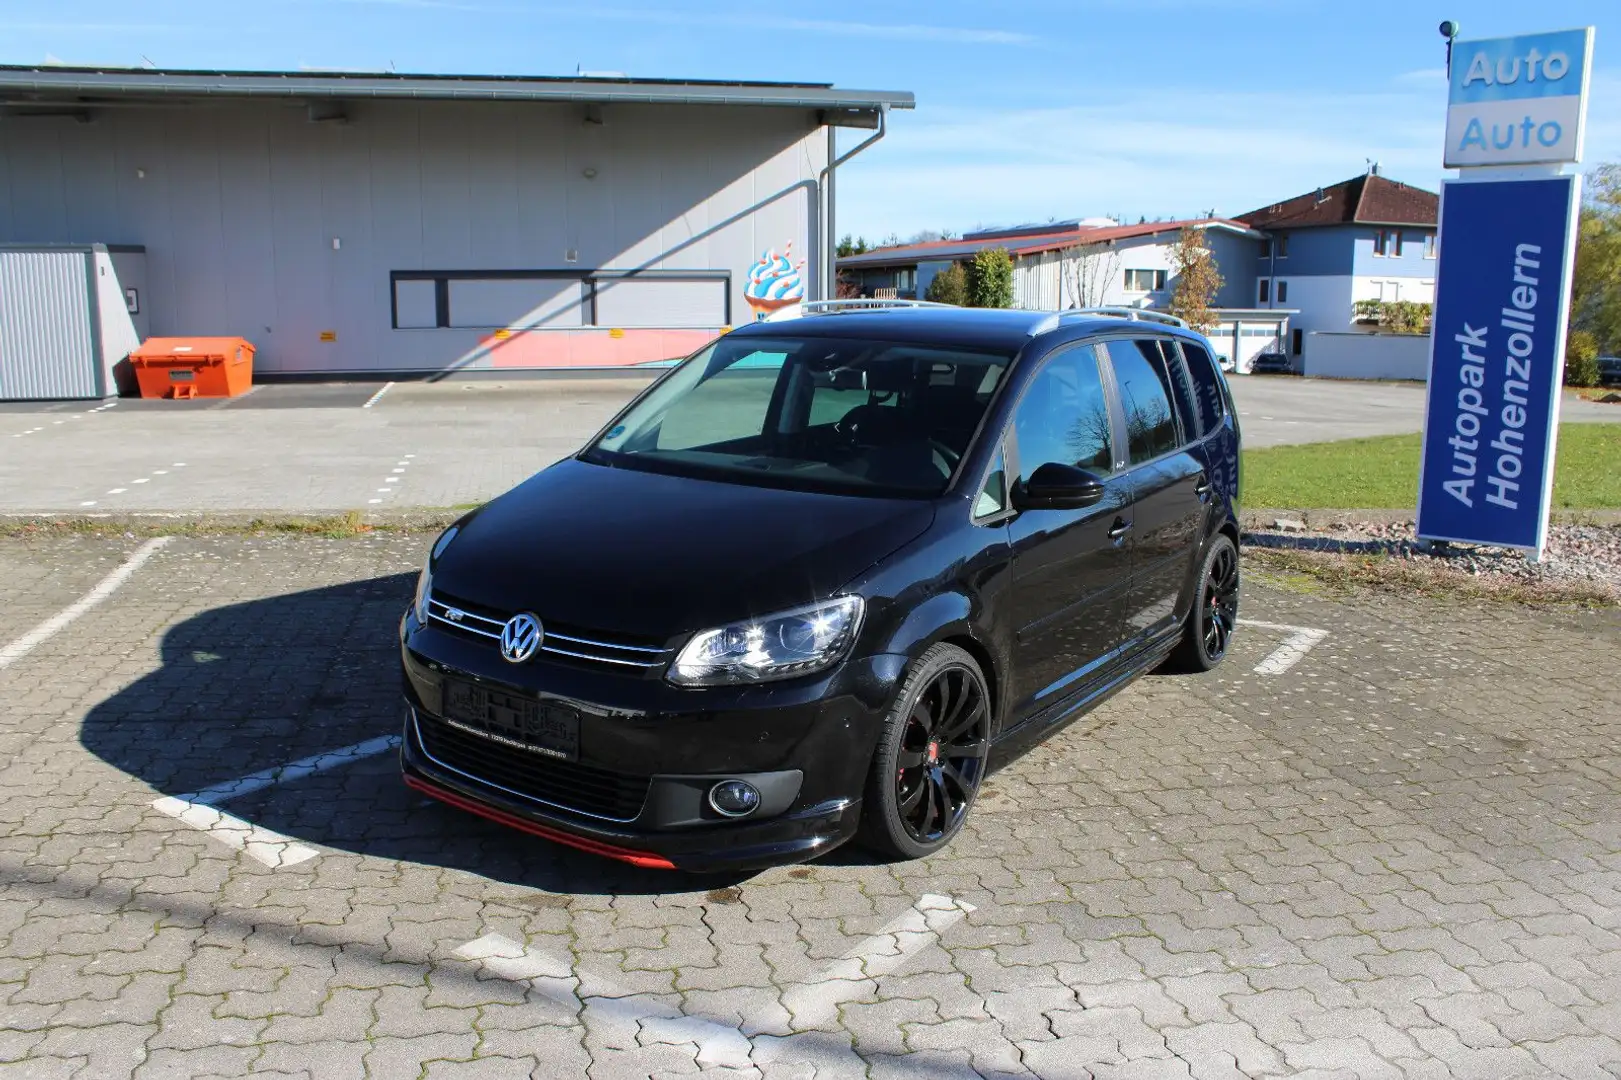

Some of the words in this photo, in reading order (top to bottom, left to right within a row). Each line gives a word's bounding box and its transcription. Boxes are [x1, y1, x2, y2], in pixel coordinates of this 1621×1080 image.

[1462, 47, 1570, 88] Auto
[1458, 116, 1562, 152] Auto
[1442, 322, 1488, 508] Autopark
[1485, 243, 1542, 510] Hohenzollern
